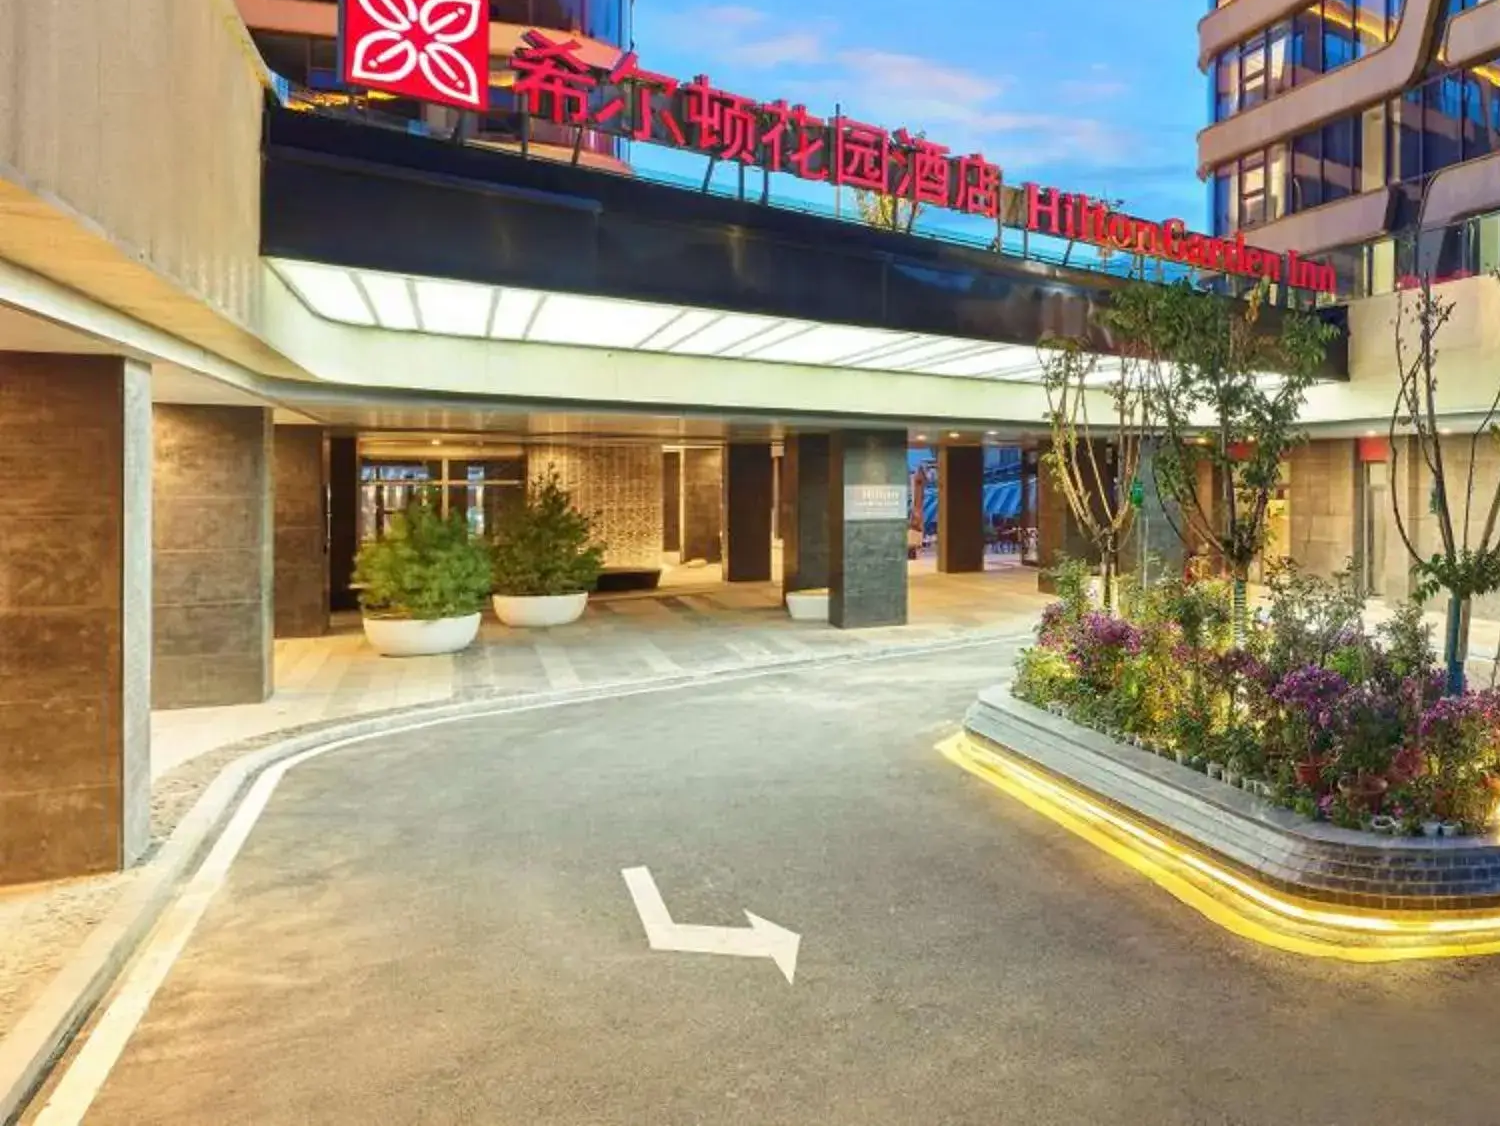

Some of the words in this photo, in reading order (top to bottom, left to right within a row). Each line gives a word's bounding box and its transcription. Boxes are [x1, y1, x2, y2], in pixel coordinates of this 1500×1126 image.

[511, 30, 1002, 219] 希尔顿花园酒店
[1022, 181, 1156, 254] Hilton
[1161, 218, 1281, 282] Garden
[1286, 249, 1338, 294] Inn
